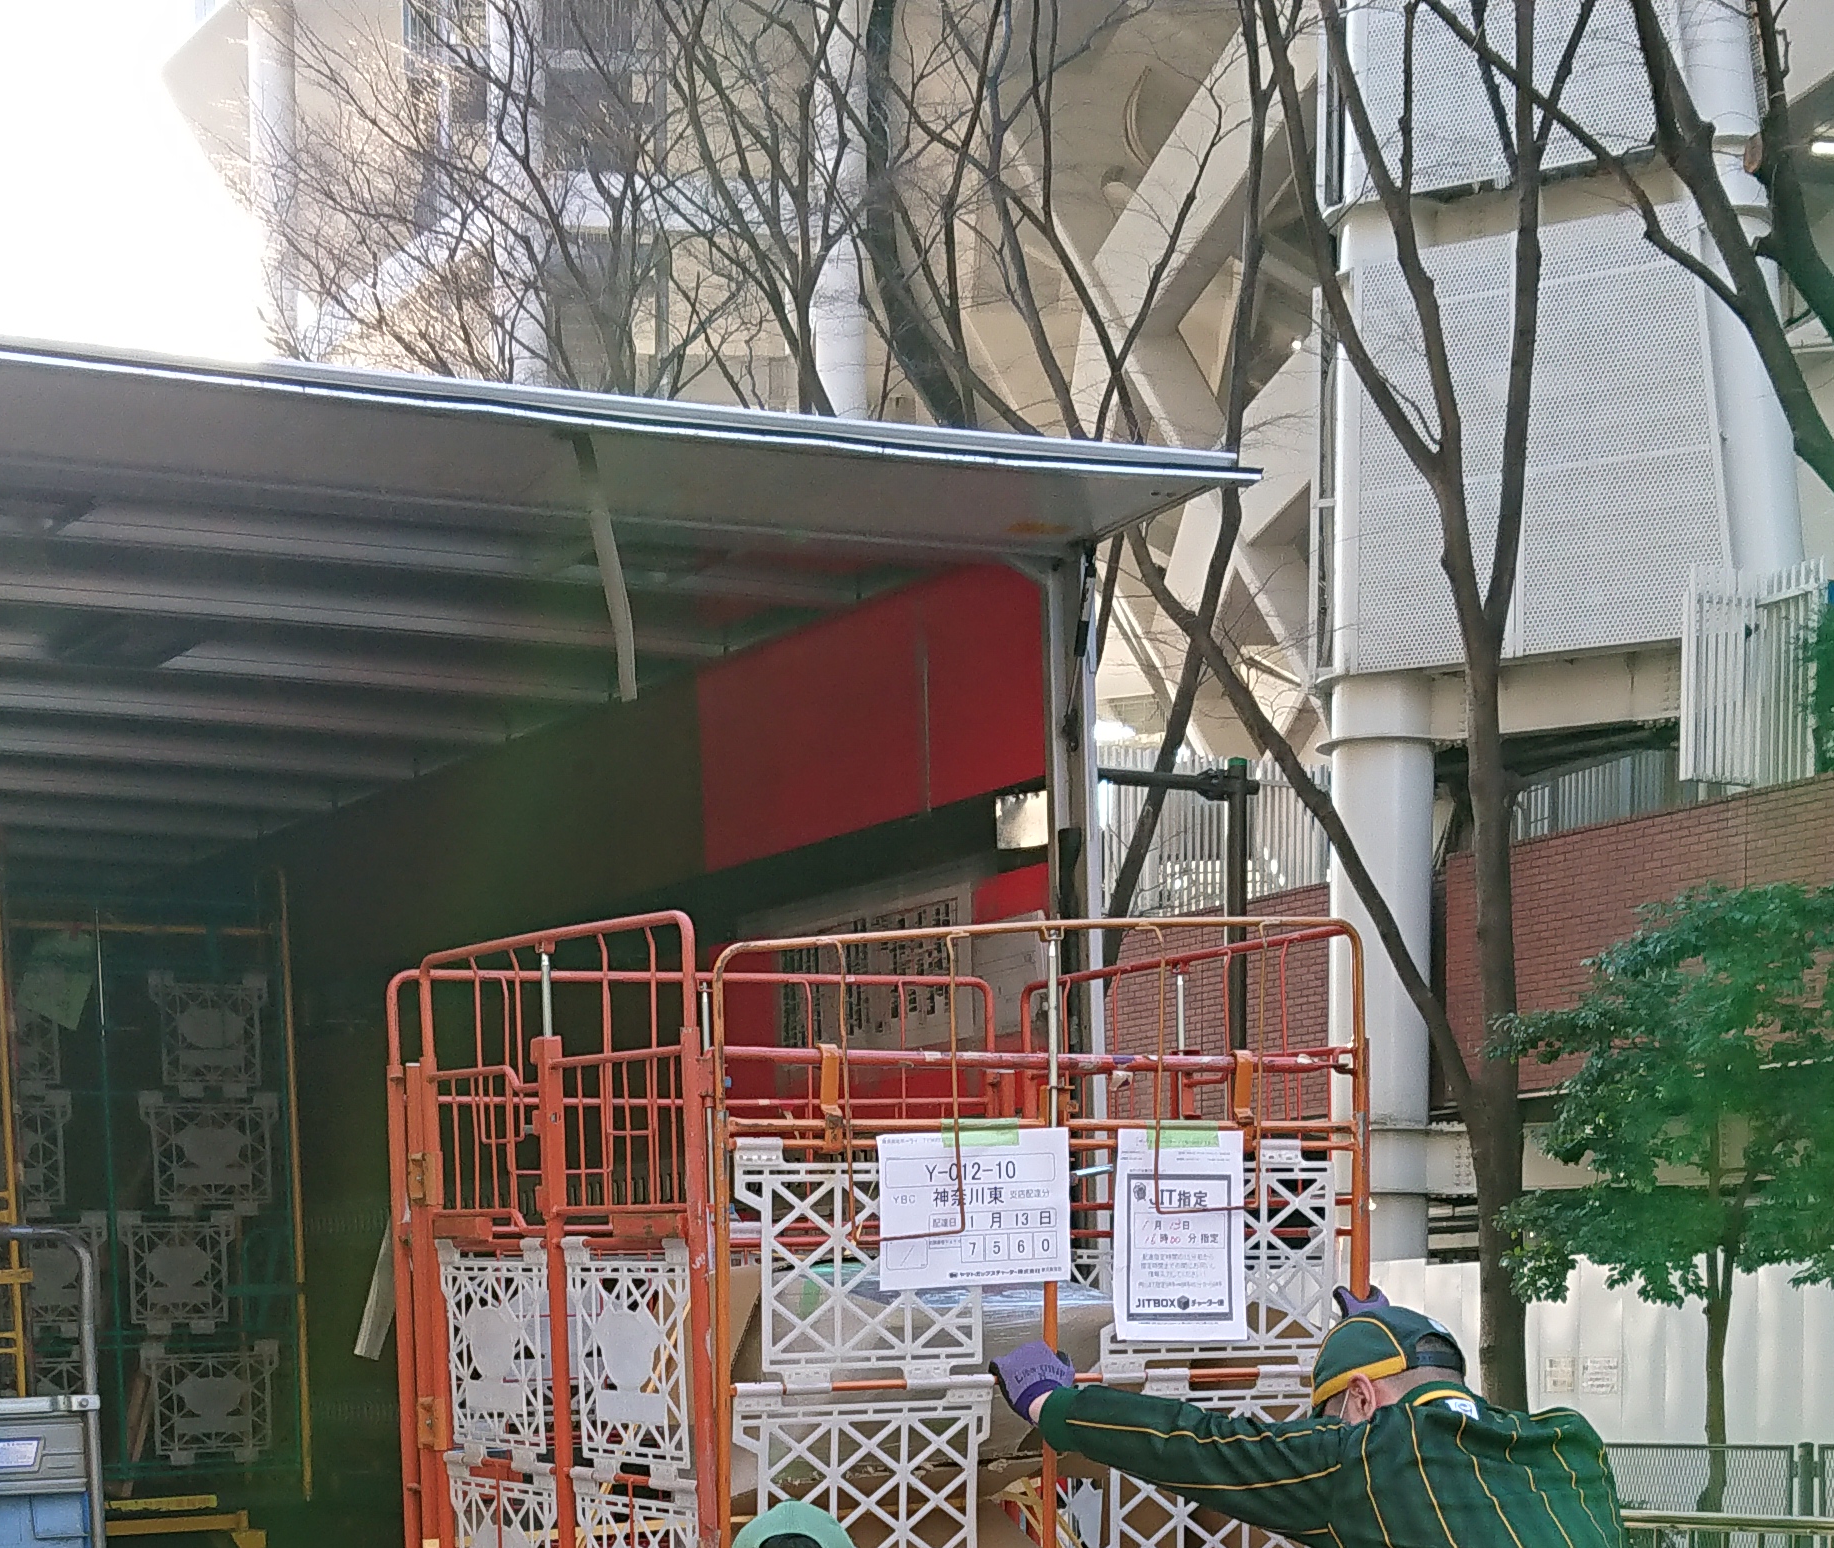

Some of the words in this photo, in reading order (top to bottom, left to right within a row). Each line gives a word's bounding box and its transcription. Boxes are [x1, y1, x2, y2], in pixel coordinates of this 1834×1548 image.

[925, 1160, 1016, 1182] Y-012-10
[893, 1194, 916, 1205] YBC
[932, 1186, 1005, 1207] 神奈川東
[932, 1217, 957, 1228] 配達日
[1135, 1298, 1177, 1308] JITBOX
